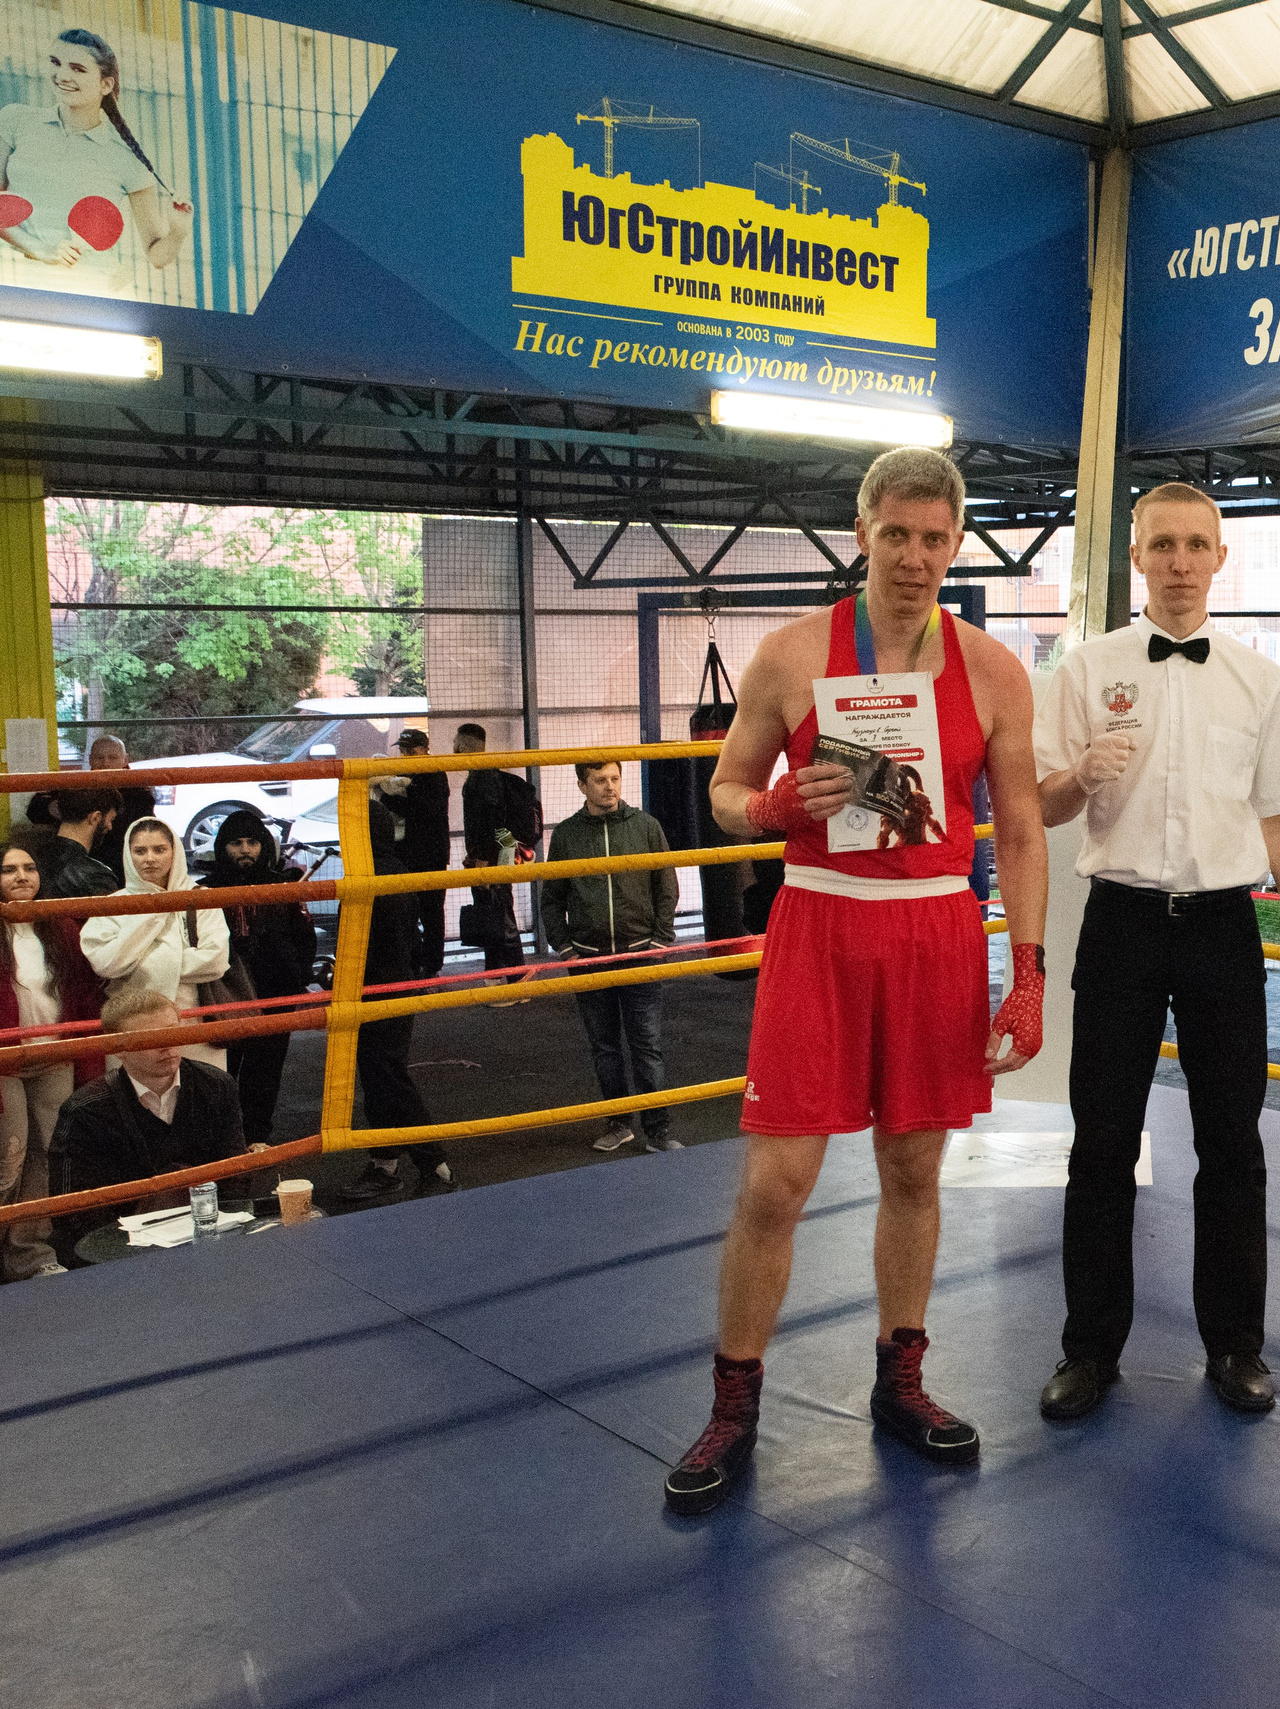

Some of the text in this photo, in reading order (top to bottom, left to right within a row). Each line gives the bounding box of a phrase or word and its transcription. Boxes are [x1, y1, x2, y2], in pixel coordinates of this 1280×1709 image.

[562, 190, 899, 292] ЮгСтройИнвест
[654, 274, 825, 316] ГРУППА КОМПАНИЙ
[677, 320, 723, 337] ОСНОВАНА
[726, 328, 732, 338] В
[735, 325, 770, 343] 2003
[513, 319, 937, 397] Нас рекомендуют друзьям!
[845, 712, 911, 721] НАГРАЖДАЕТСЯ
[850, 698, 903, 708] ГРАМОТА
